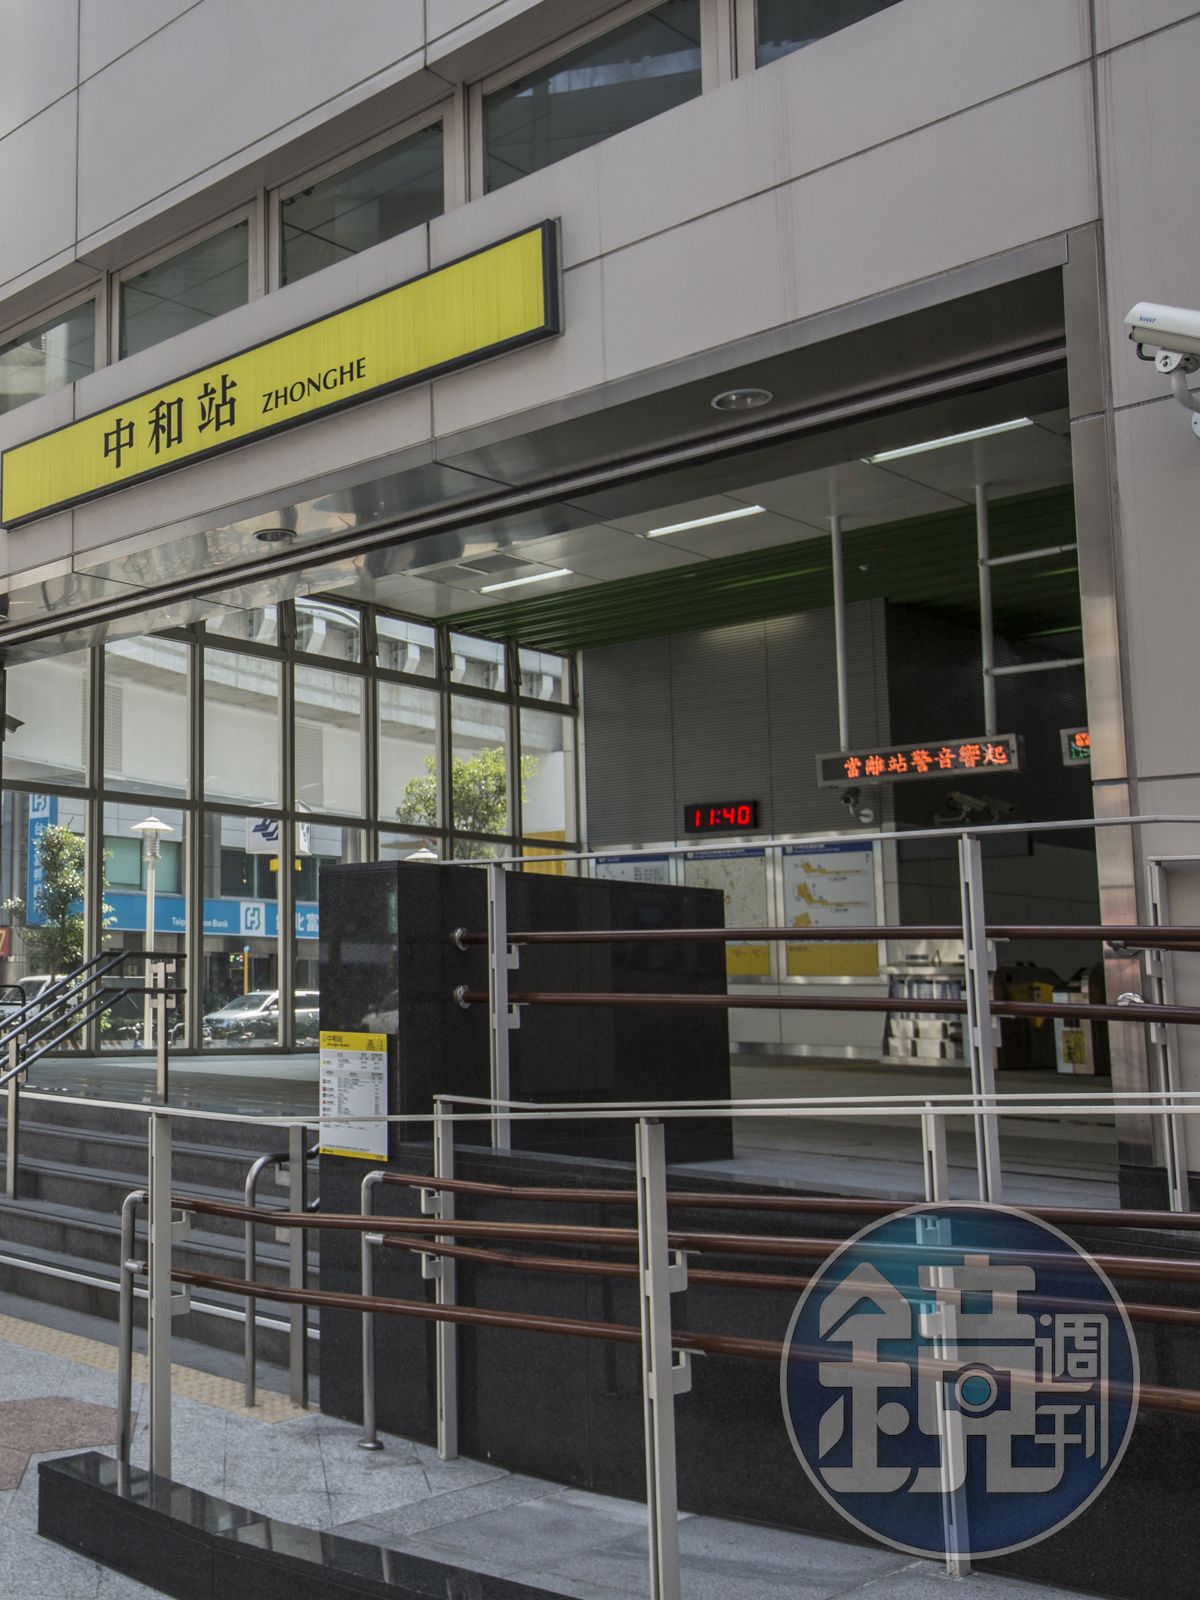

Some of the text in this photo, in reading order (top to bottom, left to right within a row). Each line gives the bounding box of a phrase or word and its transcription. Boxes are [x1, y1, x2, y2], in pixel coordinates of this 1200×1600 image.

[261, 357, 366, 414] ZHONGHE
[103, 373, 237, 469] 中和站
[844, 743, 1008, 779] 當離站警音響起
[695, 805, 750, 827] 11:40
